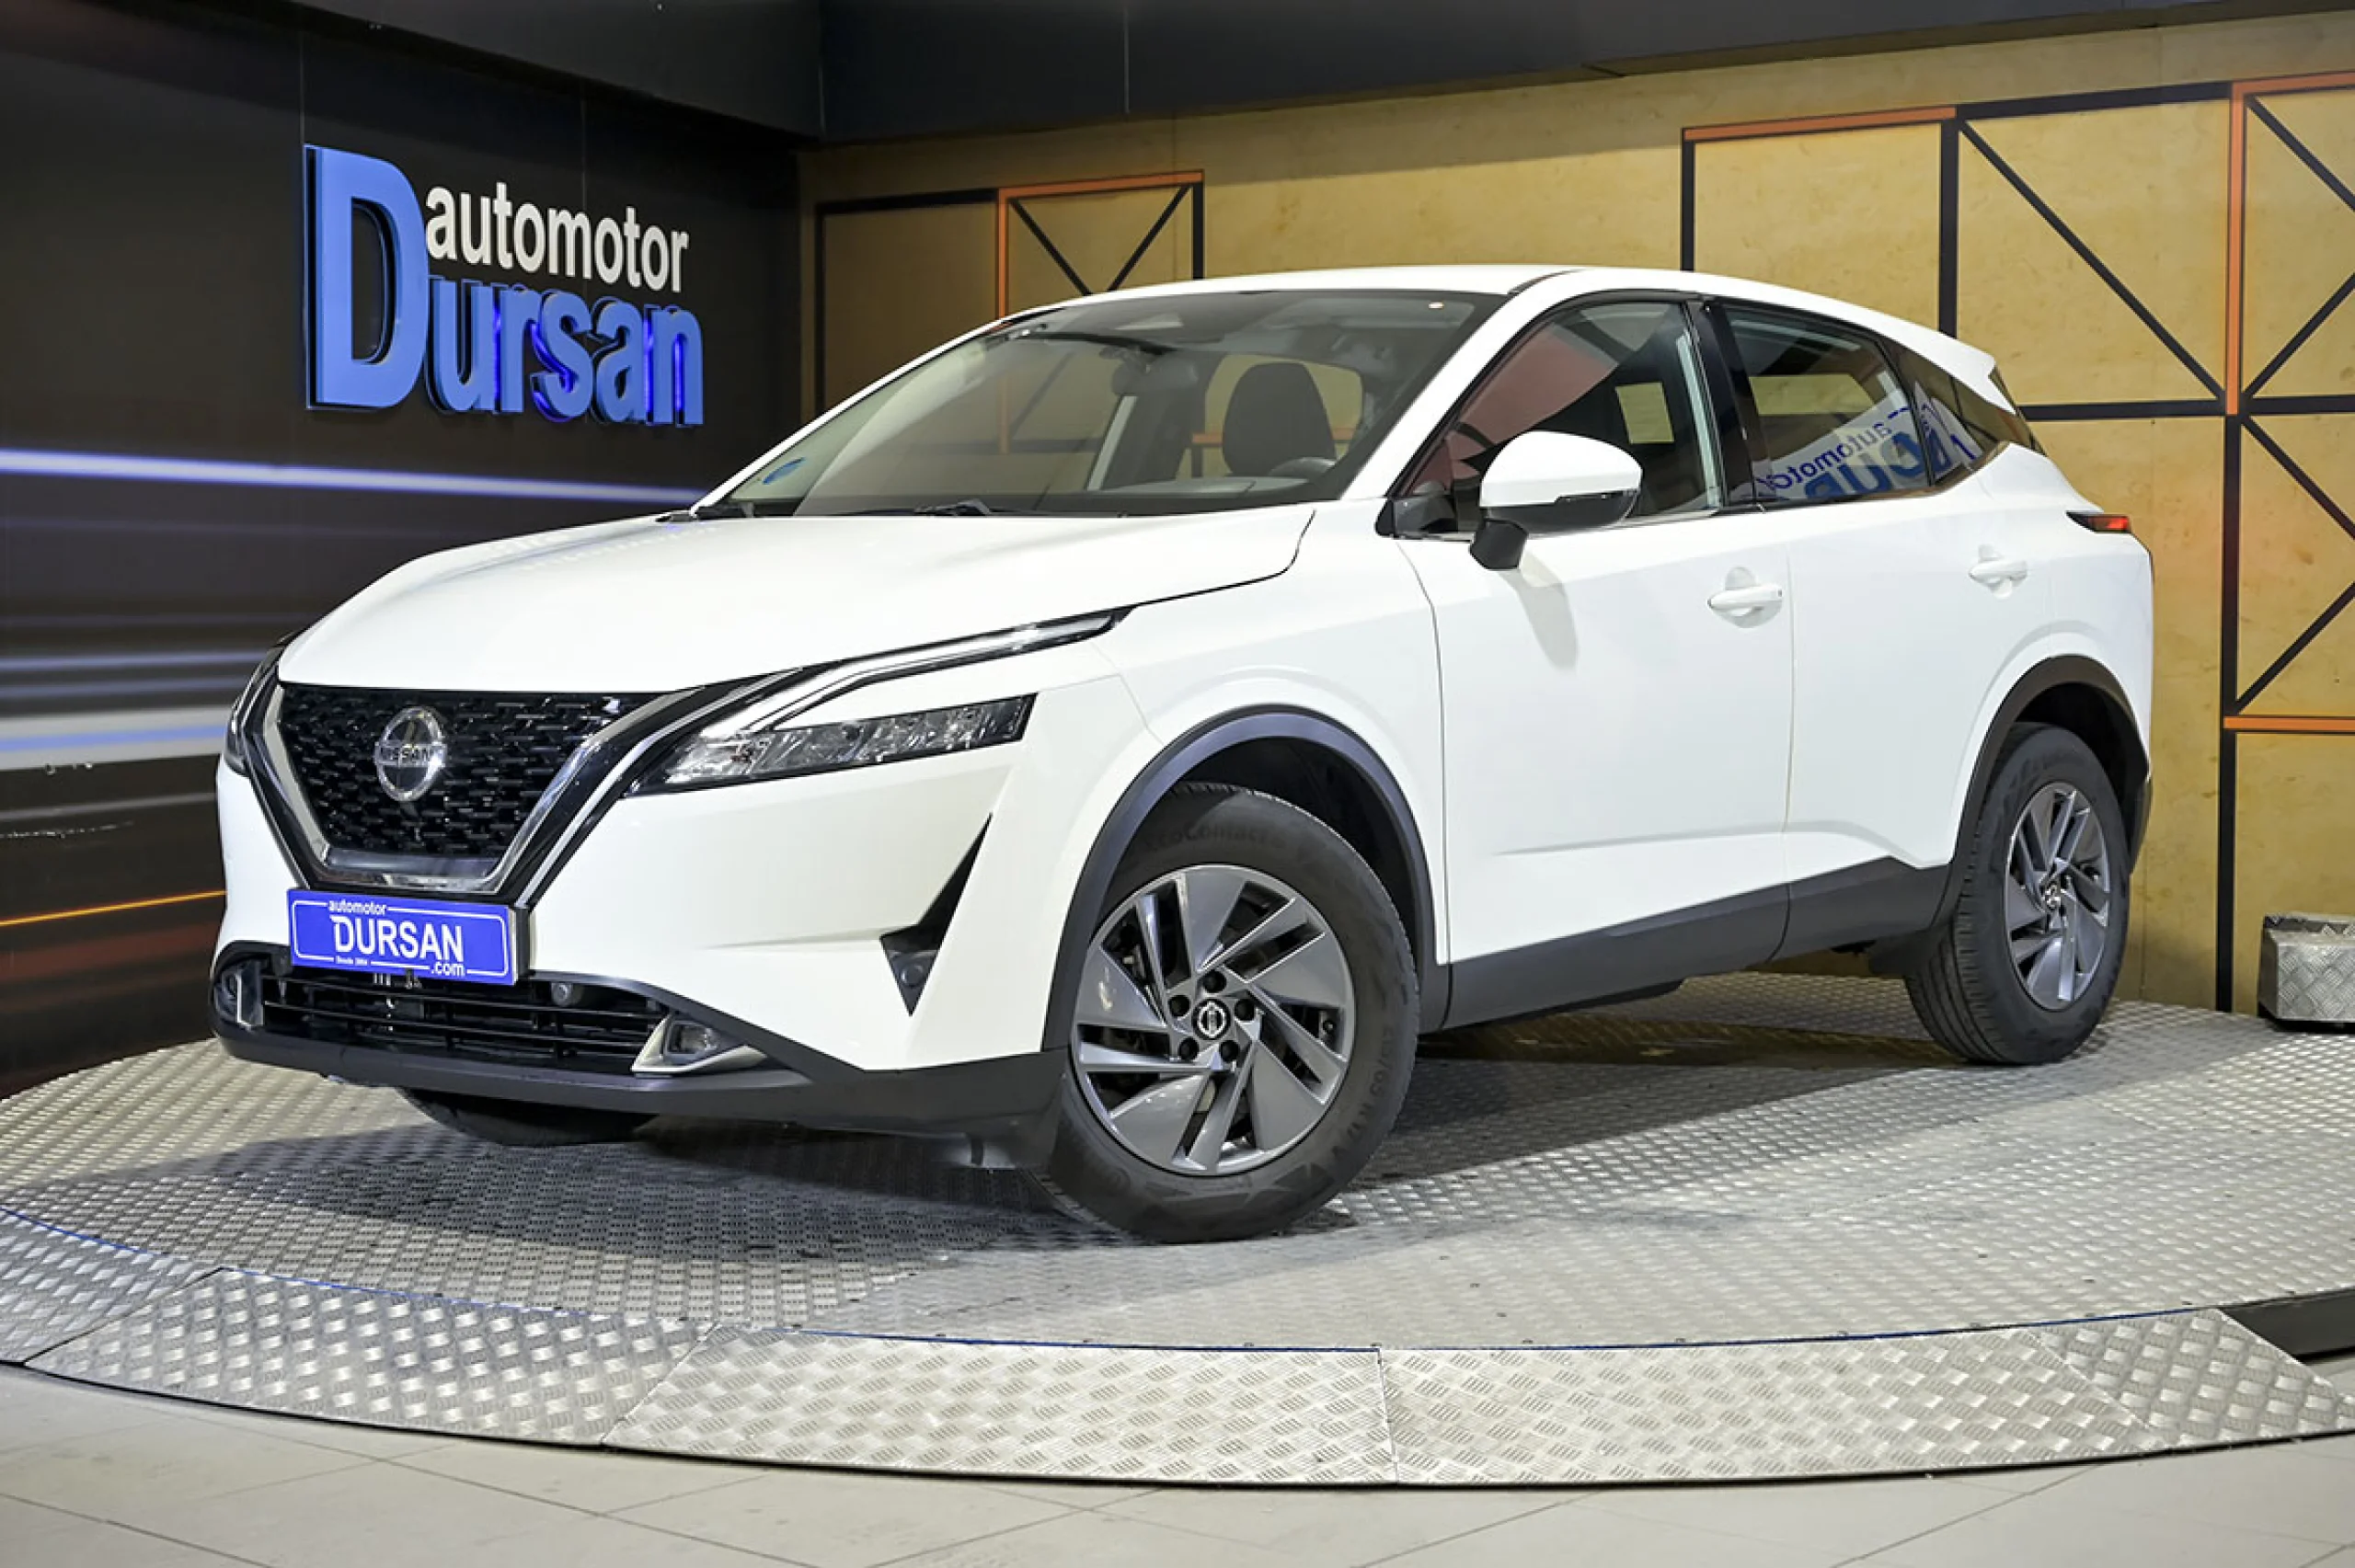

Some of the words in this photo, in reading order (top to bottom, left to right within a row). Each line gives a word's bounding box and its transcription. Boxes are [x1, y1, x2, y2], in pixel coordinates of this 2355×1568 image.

[425, 181, 690, 293] automotor
[304, 143, 705, 428] Dursan
[328, 899, 387, 915] automotor
[329, 914, 465, 962] DURSAN
[431, 961, 466, 977] .com
